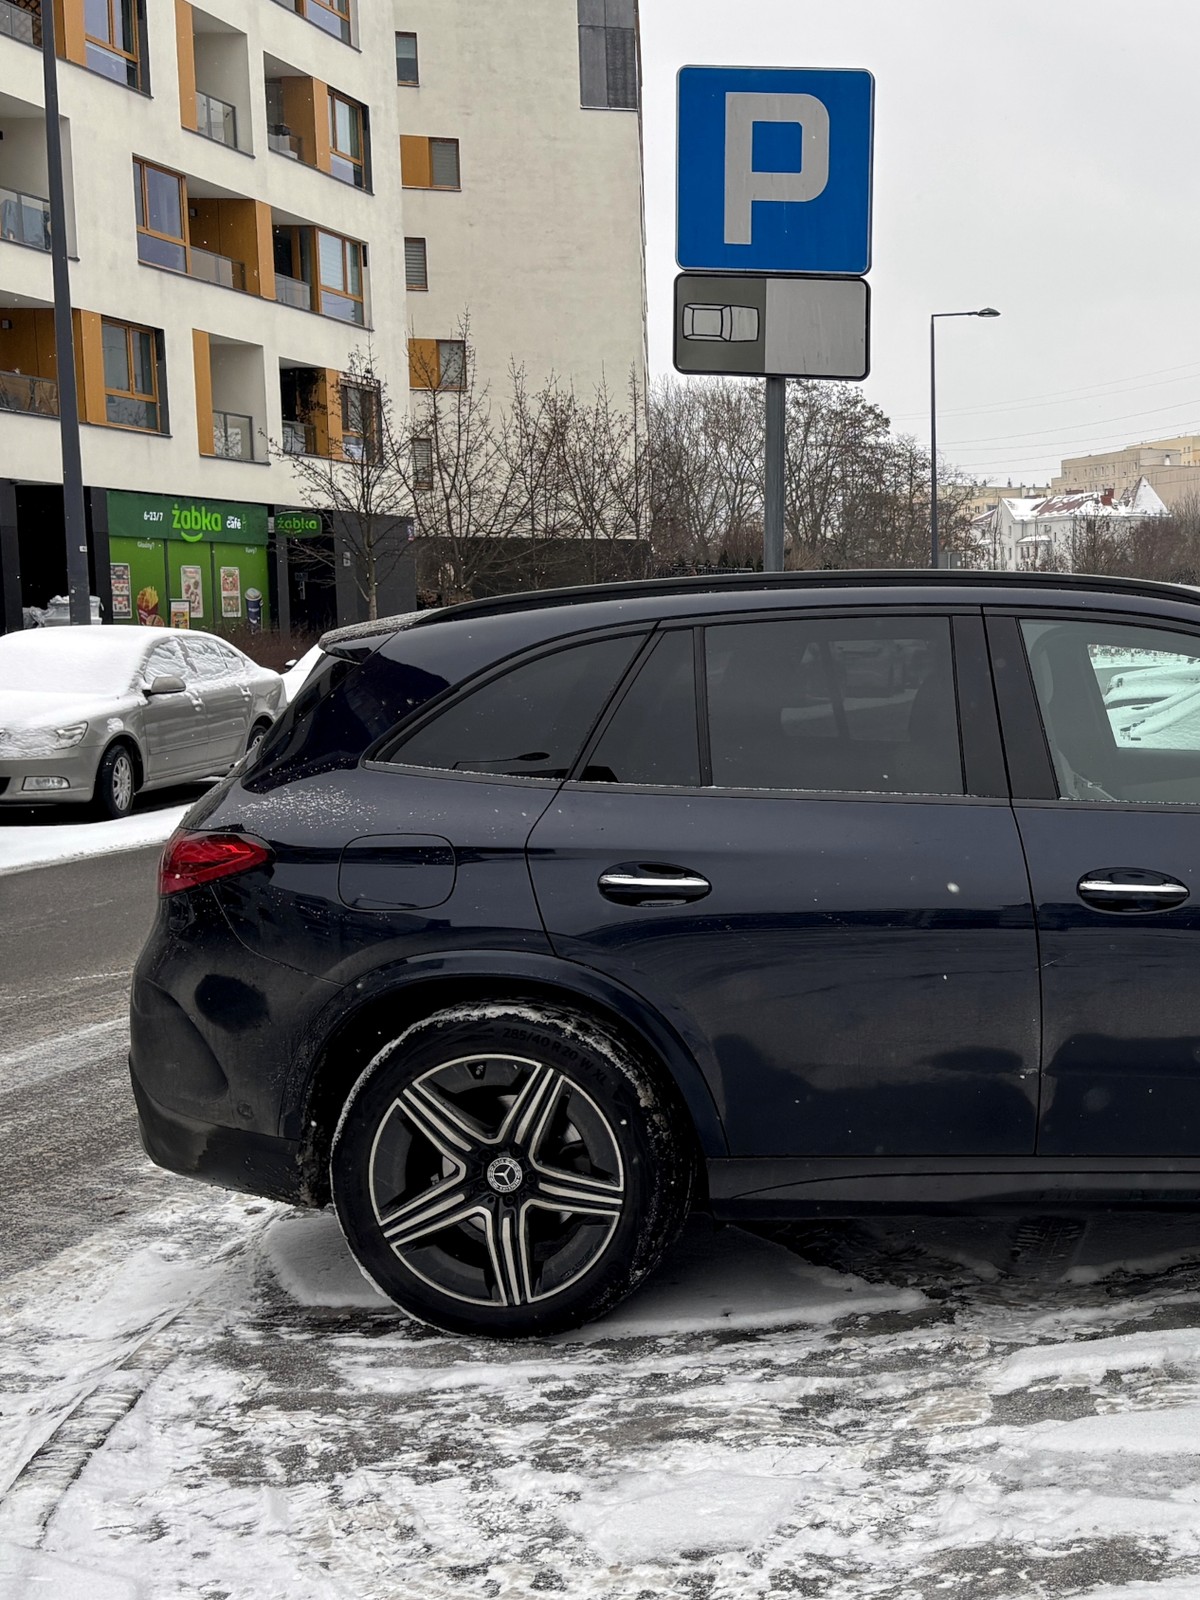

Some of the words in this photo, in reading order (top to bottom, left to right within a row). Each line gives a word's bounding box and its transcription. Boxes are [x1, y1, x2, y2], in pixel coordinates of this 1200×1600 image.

[724, 92, 830, 245] P
[143, 511, 164, 522] 6-23/7
[171, 503, 222, 532] żabka
[226, 517, 242, 530] café
[277, 517, 317, 530] żabka
[501, 1027, 552, 1048] 285/40
[550, 1039, 562, 1053] R
[560, 1044, 580, 1062] 20
[578, 1056, 594, 1072] W
[590, 1066, 610, 1086] XL
